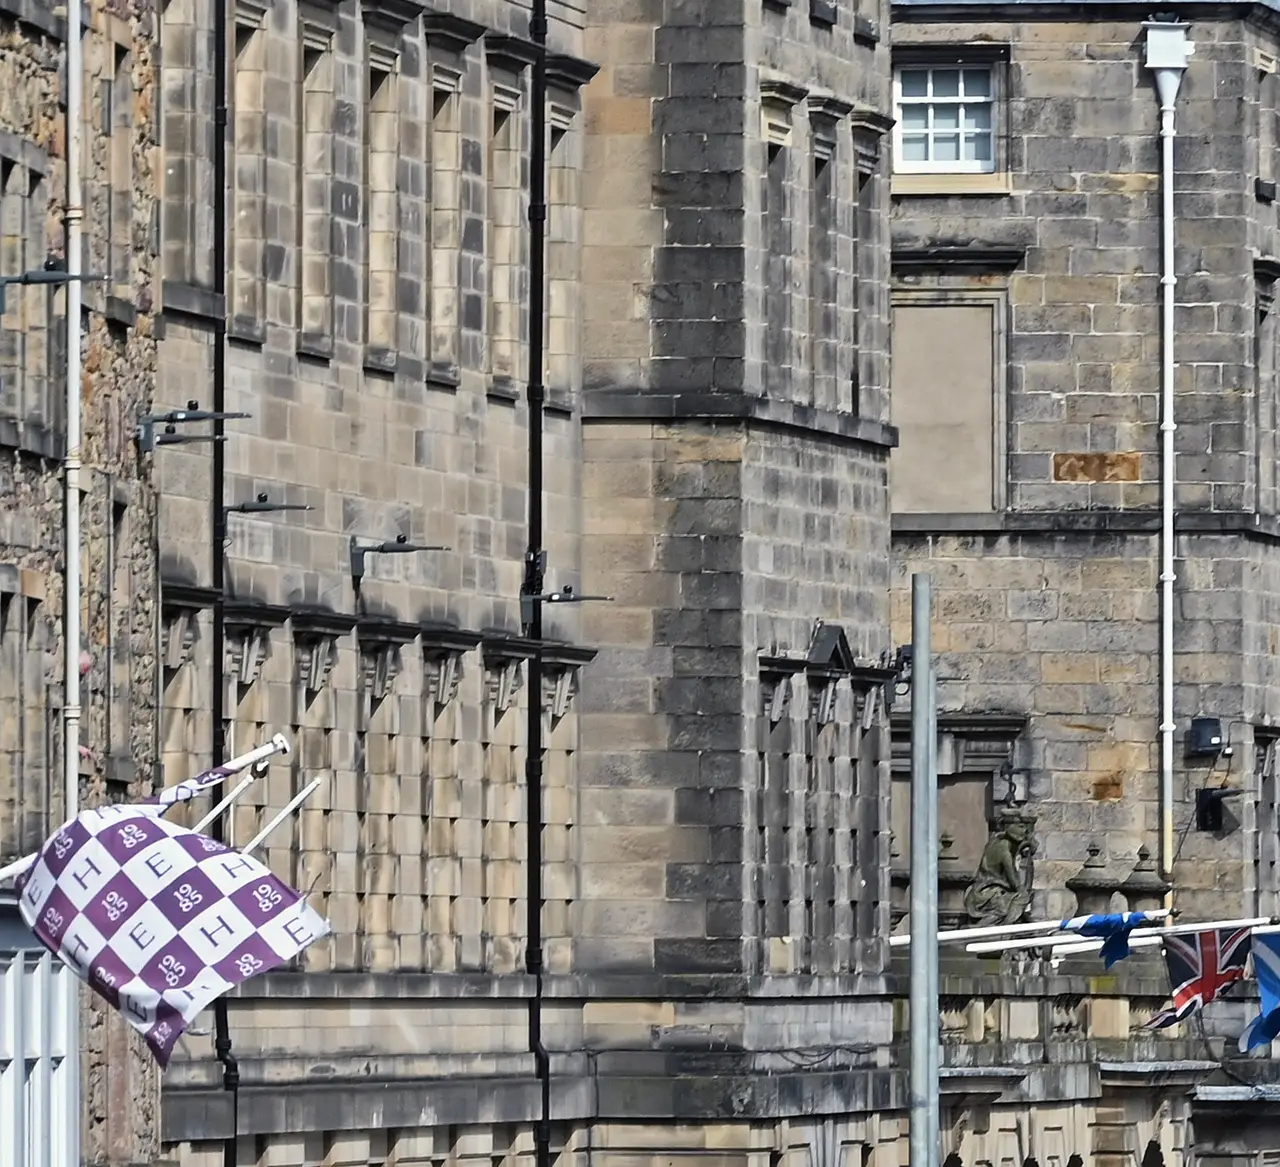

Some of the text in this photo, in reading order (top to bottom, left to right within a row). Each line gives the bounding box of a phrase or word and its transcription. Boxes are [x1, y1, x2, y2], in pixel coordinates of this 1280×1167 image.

[72, 858, 102, 890] H
[145, 852, 173, 878] E
[221, 858, 254, 879] H
[129, 922, 155, 950] E
[199, 915, 235, 947] H
[283, 917, 313, 946] E
